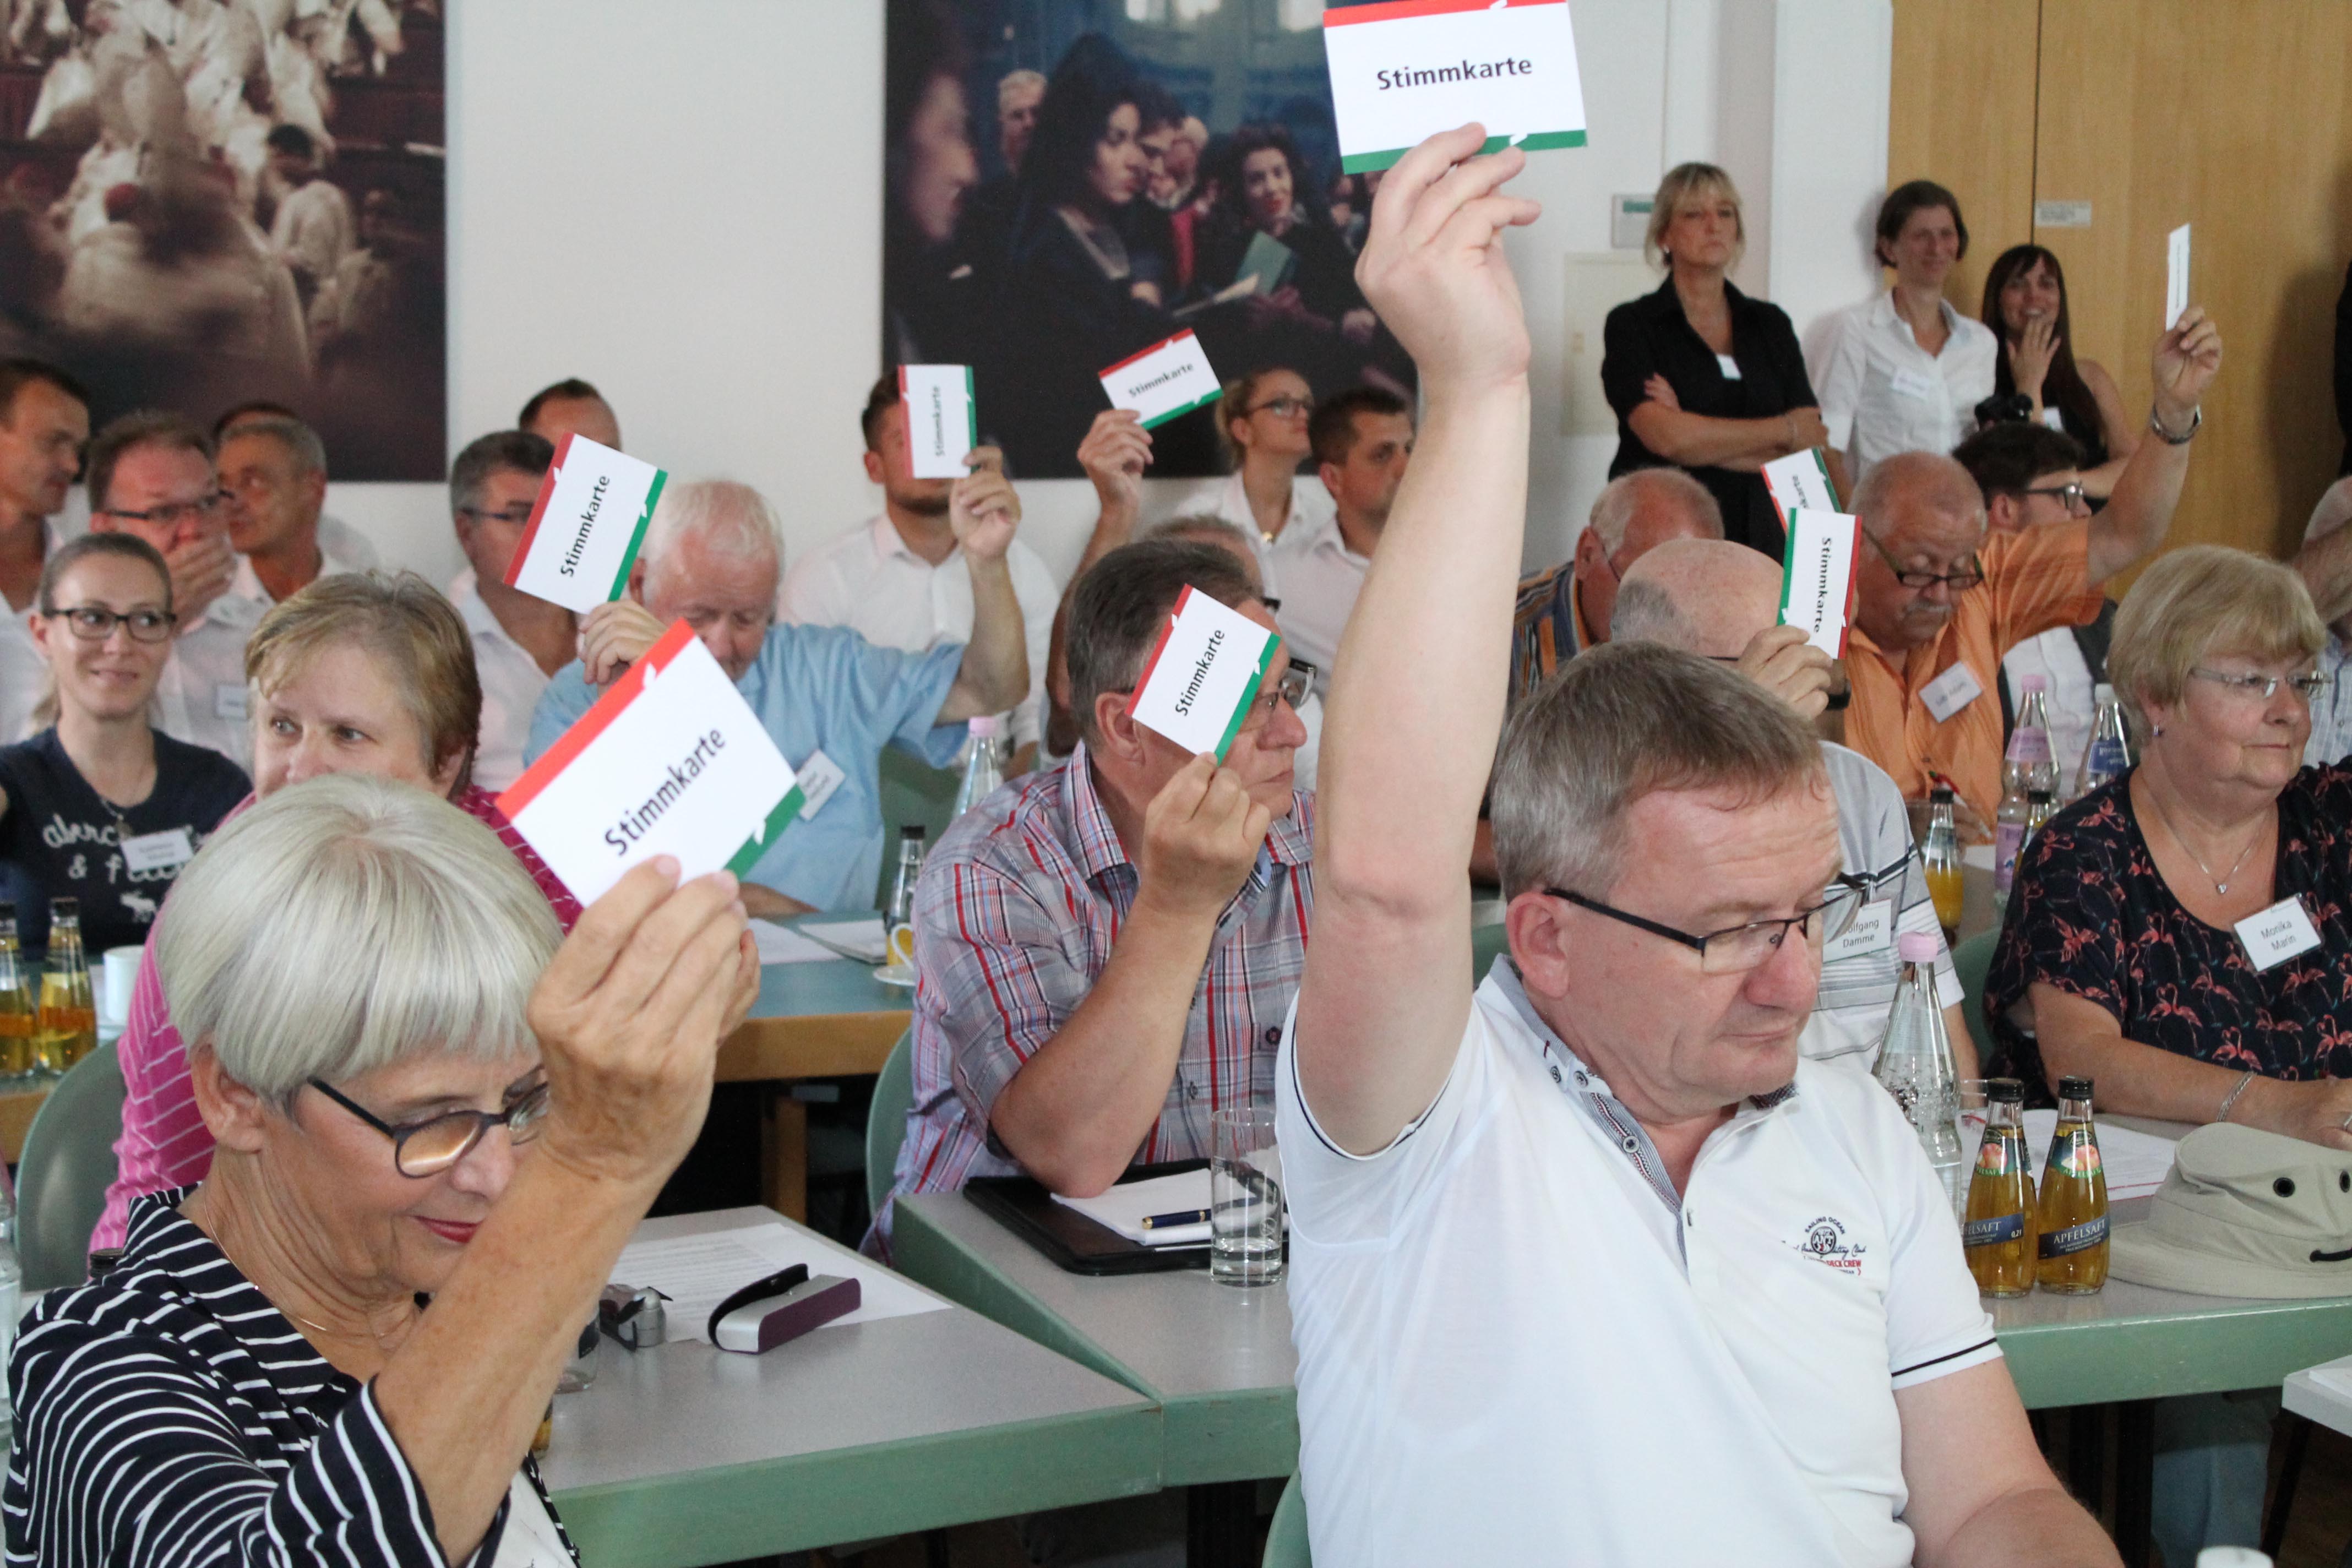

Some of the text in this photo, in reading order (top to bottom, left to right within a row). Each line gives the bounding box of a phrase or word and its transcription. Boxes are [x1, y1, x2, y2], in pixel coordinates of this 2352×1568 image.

[1377, 57, 1532, 90] Stimmkarte
[1129, 363, 1193, 397] Stimmkarte
[932, 386, 945, 456] Stimmkarte
[560, 476, 609, 577] Stimmkarte
[1814, 537, 1832, 633] Stimmkarte
[1175, 629, 1224, 716] Stimmkarte
[605, 729, 726, 856] Stimmkarte
[1843, 934, 1875, 948] Damme
[1847, 919, 1879, 934] olfgang
[2260, 921, 2293, 939] Monika
[1828, 1217, 1845, 1234] OCEAN
[1968, 1221, 2002, 1235] ELSAFT
[2054, 1218, 2106, 1244] APFELSAFT
